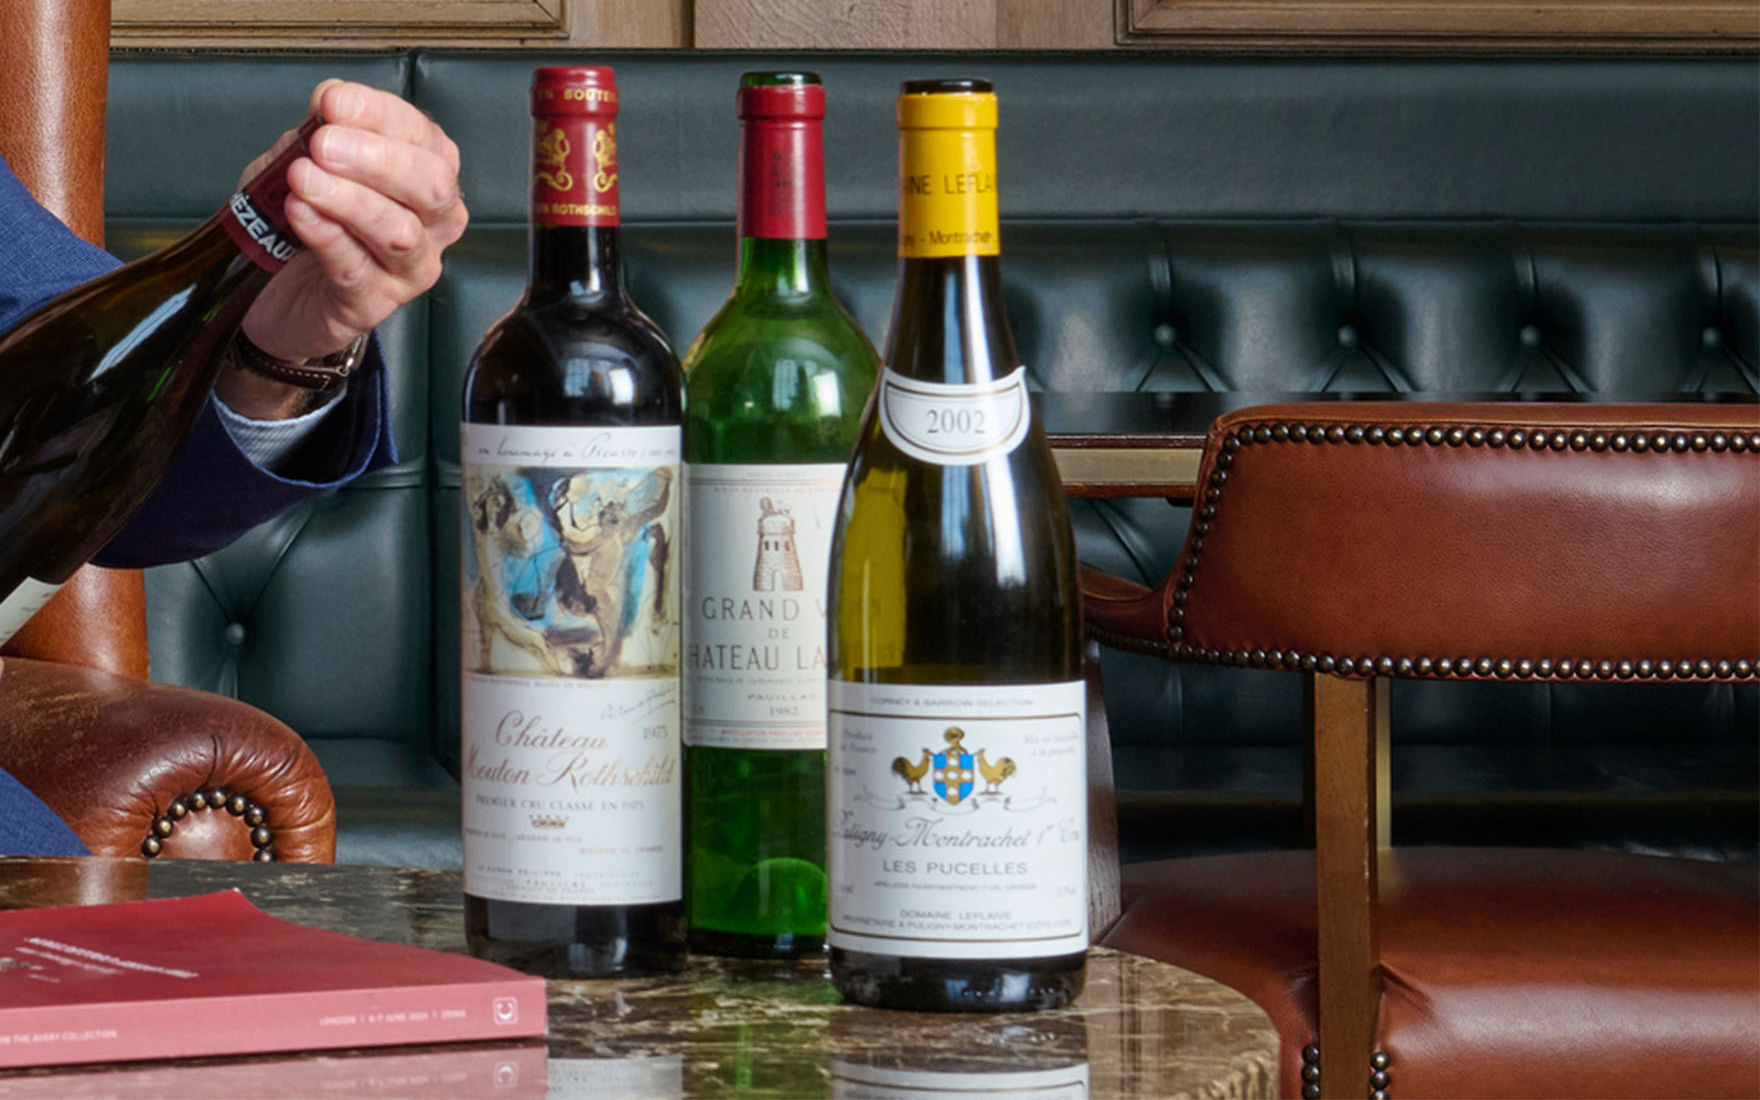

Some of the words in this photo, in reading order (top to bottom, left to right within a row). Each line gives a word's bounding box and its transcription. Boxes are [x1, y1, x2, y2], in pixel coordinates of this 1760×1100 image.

[925, 409, 986, 434] 2002
[701, 595, 801, 621] GRAND
[768, 627, 793, 640] DE
[494, 708, 610, 750] Château
[881, 859, 917, 874] LES
[926, 860, 1028, 876] PUCELLES
[900, 908, 953, 920] DOMAINE
[13, 1034, 32, 1045] THE
[61, 1030, 118, 1042] COLLECTION
